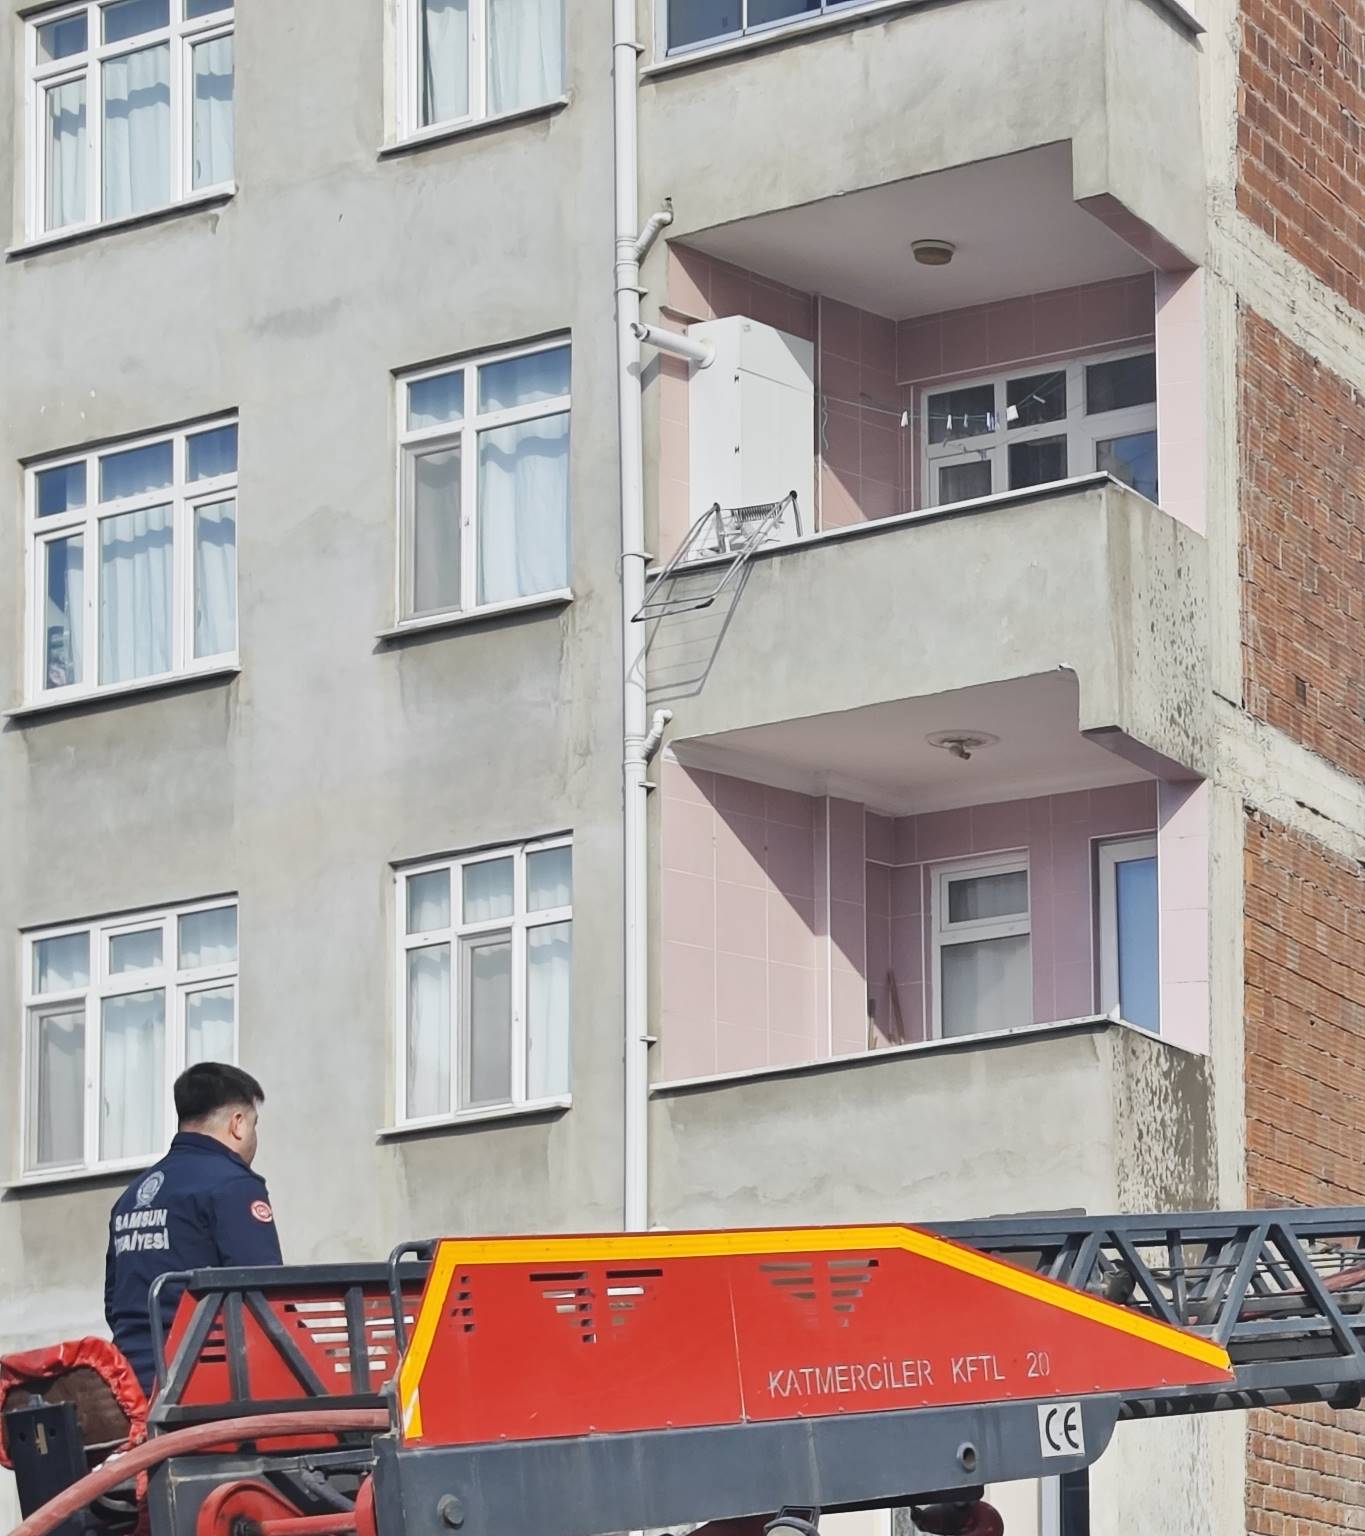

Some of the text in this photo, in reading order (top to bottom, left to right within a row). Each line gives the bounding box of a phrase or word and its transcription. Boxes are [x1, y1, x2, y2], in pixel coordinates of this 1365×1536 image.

[115, 1209, 168, 1232] SAMSUN
[768, 1352, 1050, 1398] KATMERCİLER KFTL 20
[1045, 1407, 1079, 1451] CE
